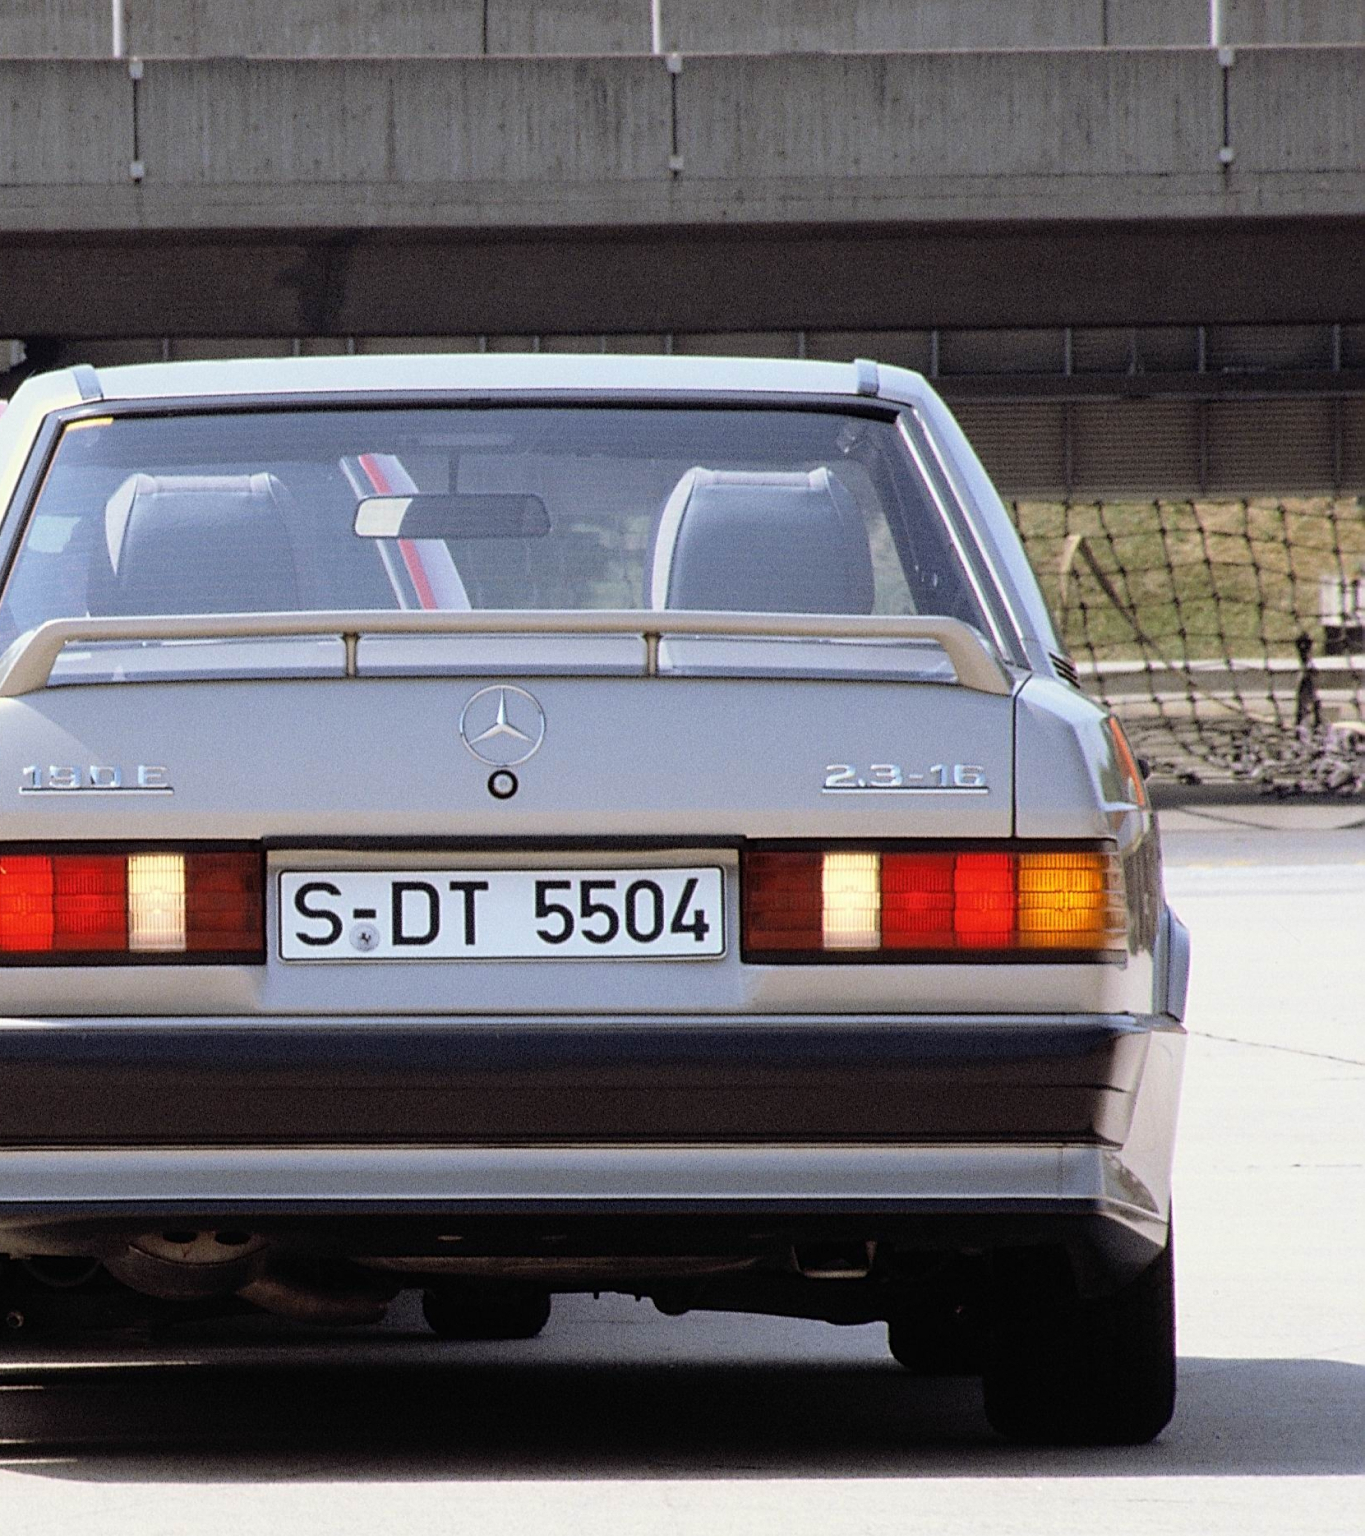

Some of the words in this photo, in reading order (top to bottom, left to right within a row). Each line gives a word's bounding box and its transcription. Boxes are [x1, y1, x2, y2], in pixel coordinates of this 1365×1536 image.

[23, 765, 122, 788] 190
[137, 765, 168, 788] E
[825, 764, 985, 787] 2.3-16
[535, 878, 710, 944] 5504
